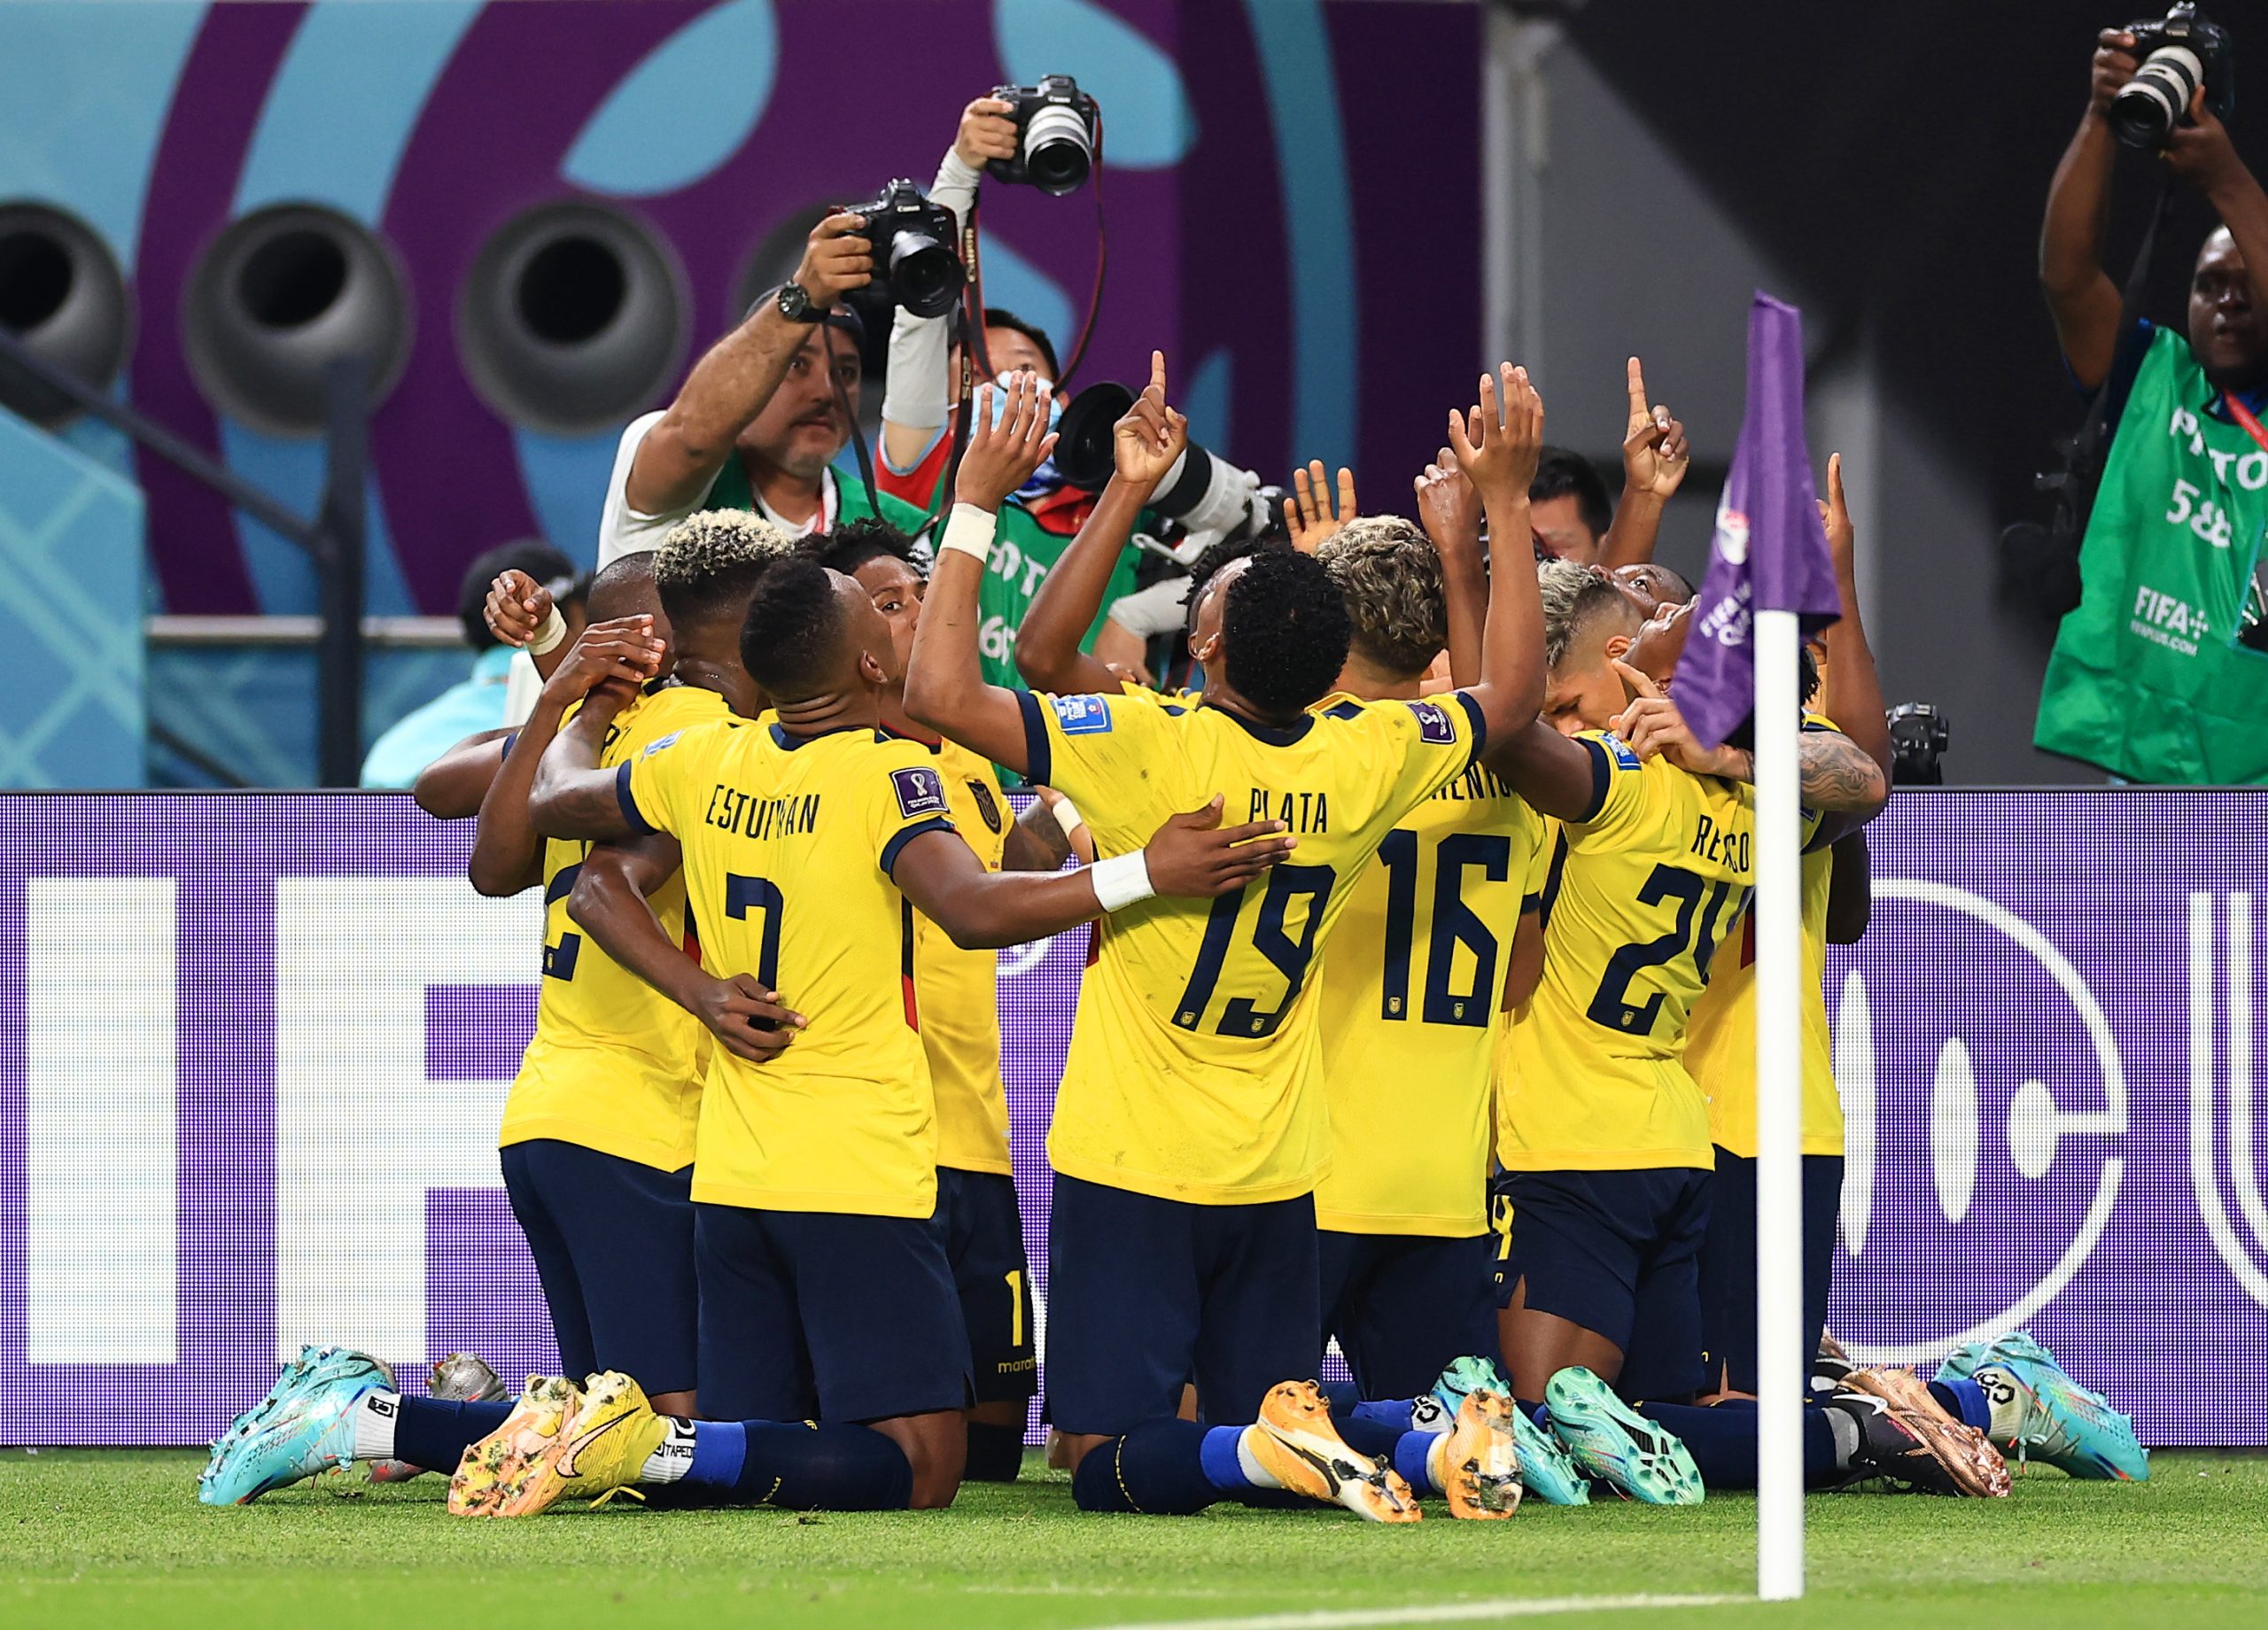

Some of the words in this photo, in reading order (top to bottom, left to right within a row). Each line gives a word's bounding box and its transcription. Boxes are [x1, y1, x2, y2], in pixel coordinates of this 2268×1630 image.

[725, 872, 784, 1031] 7
[1170, 864, 1337, 1040] 19
[1377, 828, 1511, 1028] 16
